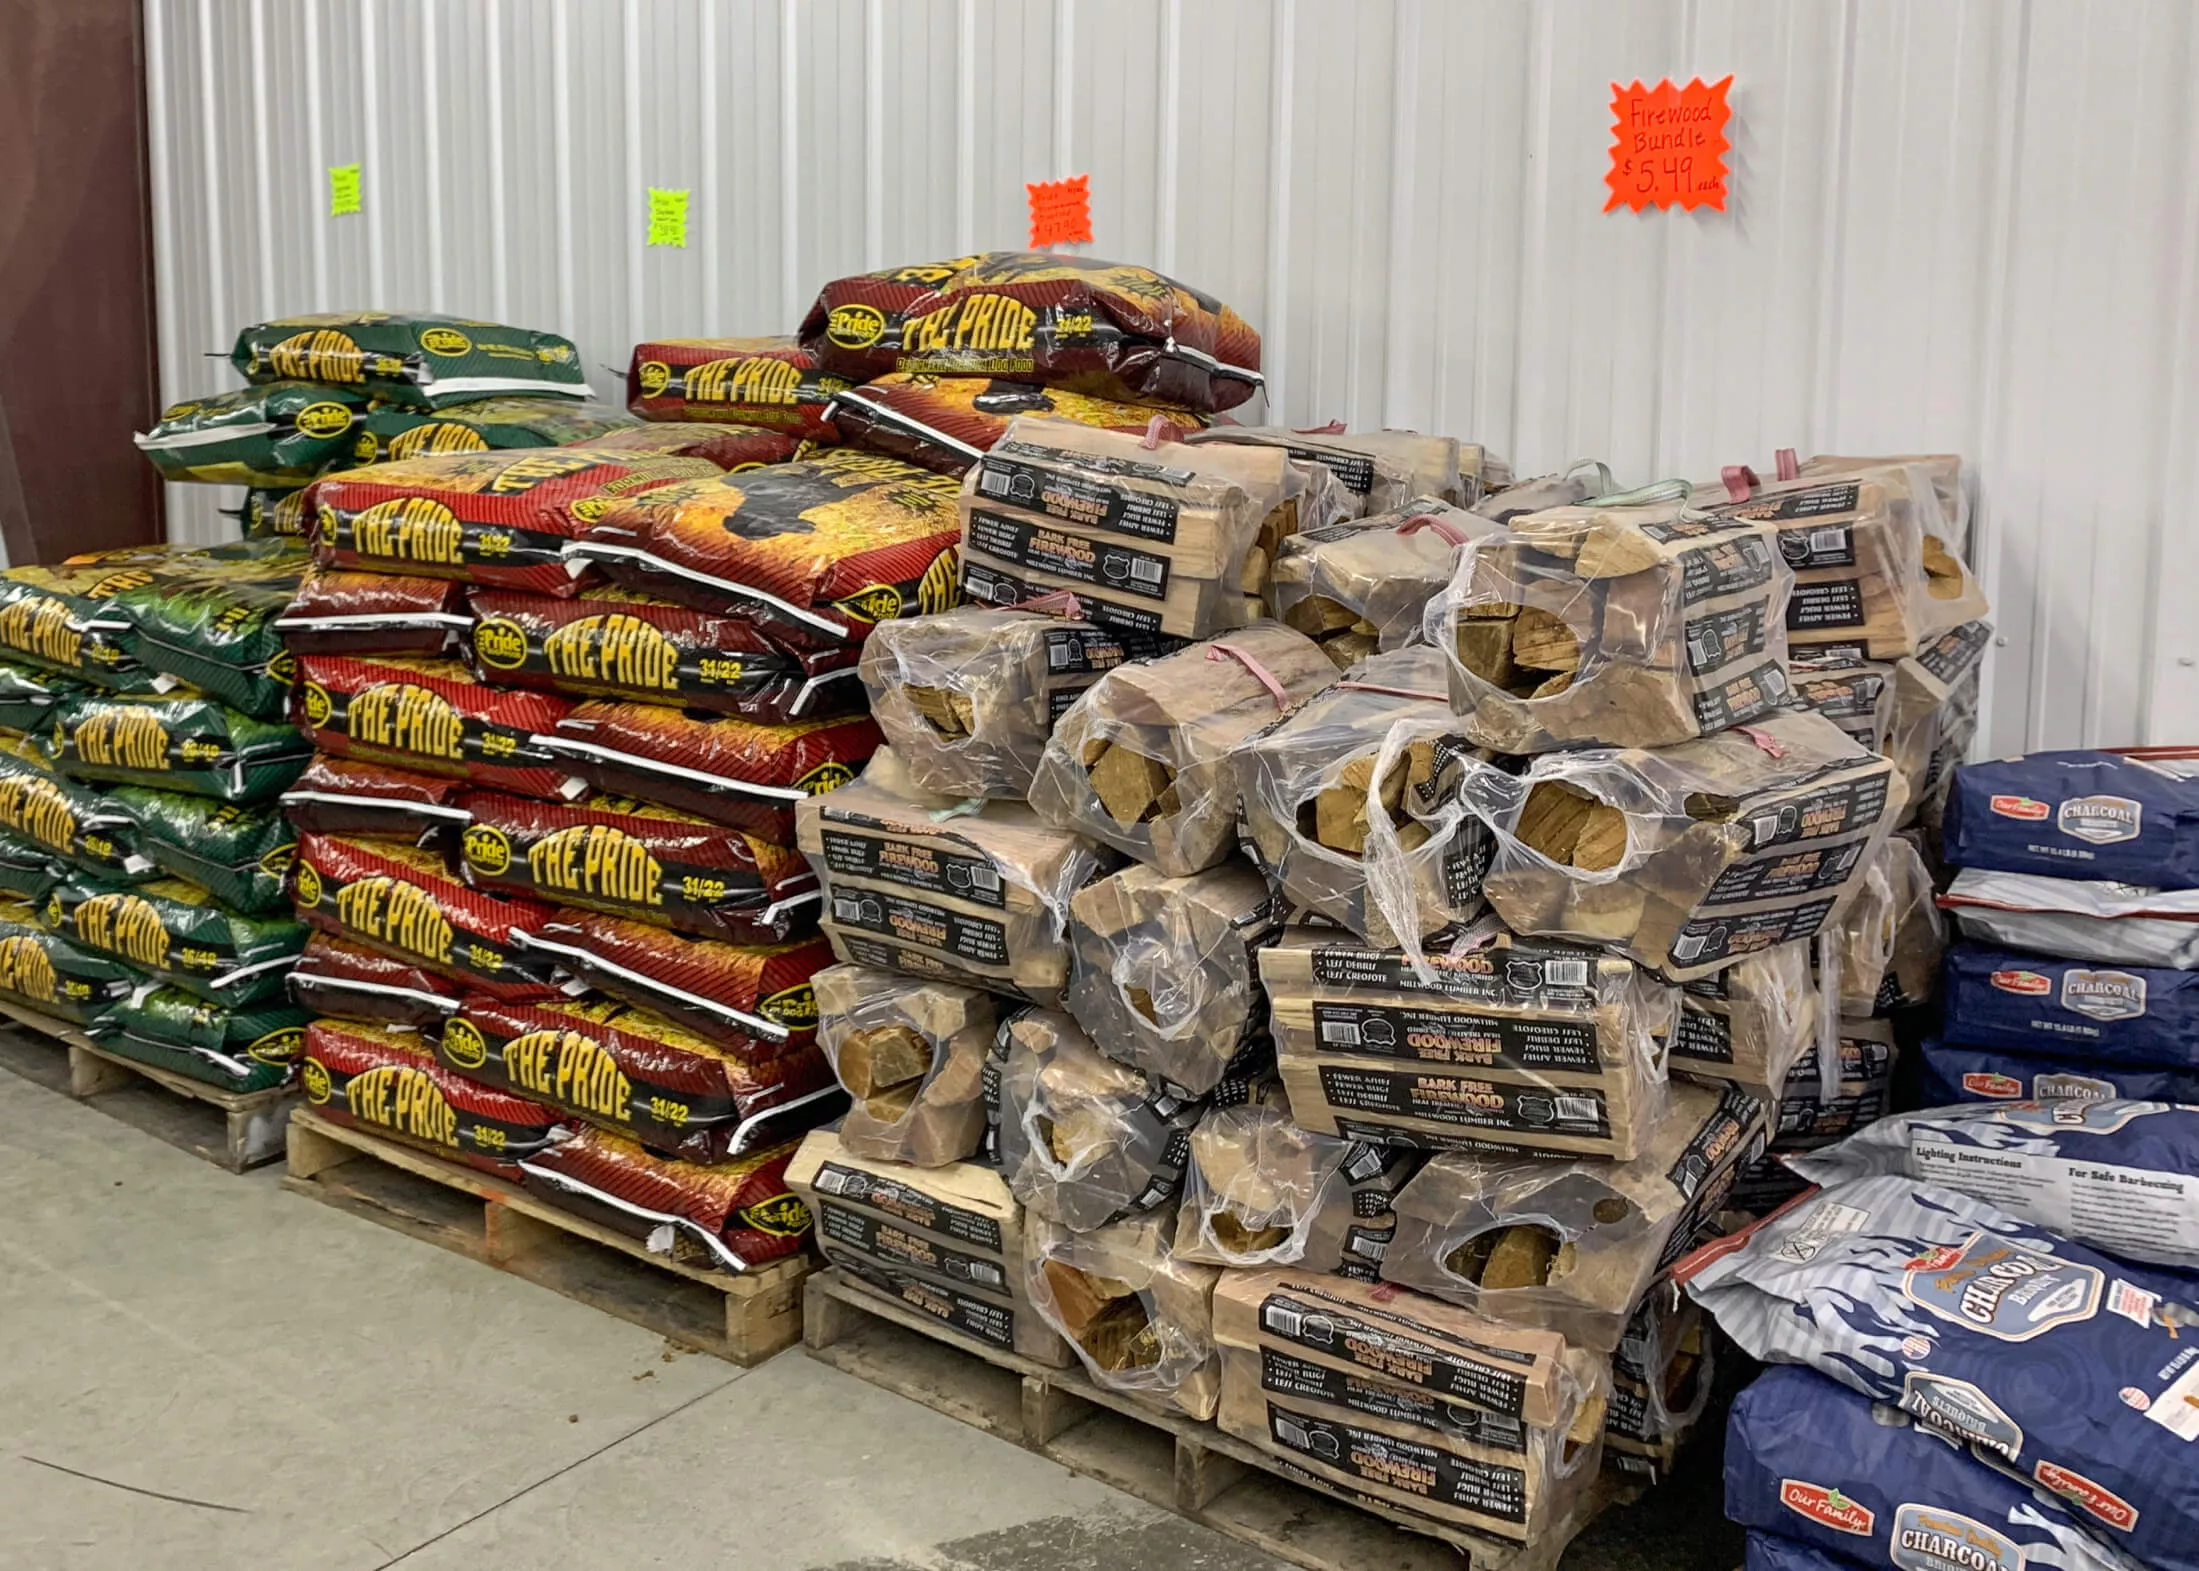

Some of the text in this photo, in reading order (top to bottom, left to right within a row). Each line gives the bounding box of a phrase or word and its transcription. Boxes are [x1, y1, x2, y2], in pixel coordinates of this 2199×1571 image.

[1631, 97, 1713, 127] Firewood
[1634, 127, 1706, 154] Bundle
[836, 311, 880, 331] Pride
[954, 293, 1037, 351] PRIDE
[1055, 316, 1094, 333] 31/22
[269, 329, 366, 384] THE PRIDE
[685, 357, 803, 405] THE PRIDE
[352, 496, 463, 565] THE PRIDE
[1028, 537, 1096, 563] FIREWOOD
[32, 597, 83, 668] PRIDE
[484, 627, 522, 650] Pride
[544, 612, 680, 691] THE PRIDE
[699, 659, 742, 680] 31/22
[348, 682, 465, 760] THE PRIDE
[75, 705, 172, 771] THE PRIDE
[23, 776, 76, 855] PRIDE
[2063, 805, 2134, 824] CHARCOAL
[467, 835, 507, 862] Pride
[528, 824, 664, 906] THE PRIDE
[879, 849, 939, 873] FIREWOOD
[682, 876, 725, 897] 31/22
[75, 893, 171, 971] THE PRIDE
[336, 876, 454, 965] THE PRIDE
[1325, 961, 1377, 971] LESS DEBRIS
[1326, 971, 1388, 983] LESS CREOSOTE
[1444, 984, 1479, 996] LUMBER
[1482, 987, 1499, 997] INC.
[2067, 982, 2139, 1001] CHARCOAL
[1418, 1012, 1452, 1023] LUMBER
[1453, 1016, 1499, 1026] MILLWOOD
[1513, 1023, 1582, 1037] LESS CREOSOTE
[1526, 1034, 1583, 1046] LESS DEBRIS
[1406, 1032, 1503, 1053] FIREWOOD
[1524, 1043, 1585, 1055] FEWER BUGS
[1418, 1047, 1493, 1065] BARK FREE
[1522, 1052, 1587, 1064] FEWER ASHES
[502, 1030, 631, 1121] THE PRIDE
[1333, 1073, 1390, 1086] FEWER ASHES
[1417, 1076, 1494, 1094] BARK FREE
[1335, 1081, 1389, 1094] FEWER BUGS
[1409, 1087, 1505, 1110] FIREWOOD
[345, 1065, 460, 1147] THE PRIDE
[650, 1095, 689, 1122] 31/22
[1414, 1111, 1515, 1128] MILLWOOD LUMBER INC.
[1915, 1146, 2023, 1169] Lighting Instructions
[2068, 1167, 2185, 1194] For Safe Barbecuing
[1960, 1254, 2065, 1324] CHARCOAL
[1301, 1370, 1326, 1380] BUGS
[1274, 1378, 1293, 1389] LESS
[1294, 1382, 1336, 1398] CREOSOTE
[1347, 1398, 1388, 1414] MILLWOOD
[1389, 1406, 1422, 1422] LUMBER
[1363, 1431, 1395, 1446] LUMBER
[1396, 1440, 1438, 1458] MILLWOOD
[1350, 1450, 1437, 1487] FIREWOOD
[1359, 1465, 1428, 1495] BARK FREE
[1490, 1471, 1511, 1481] LESS
[1455, 1481, 1481, 1495] BUGS
[1453, 1490, 1512, 1513] FEWER ASHES
[1788, 1487, 1868, 1532] Our Family
[2096, 1499, 2128, 1521] Our
